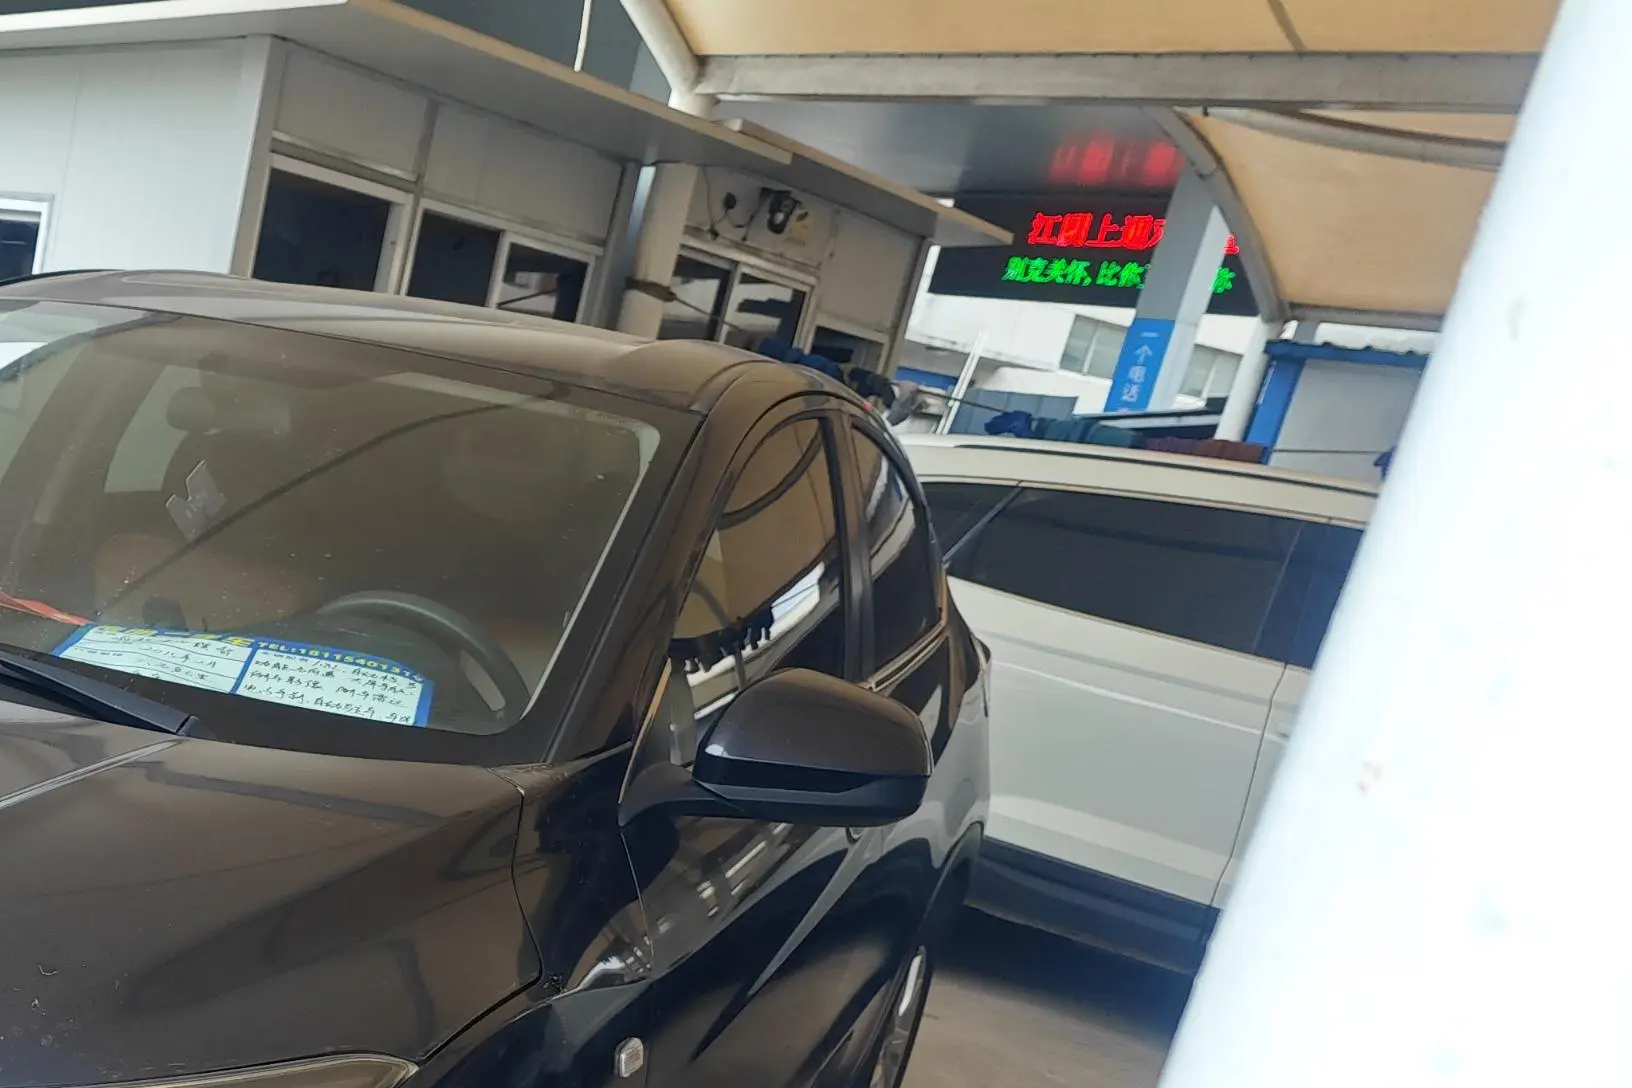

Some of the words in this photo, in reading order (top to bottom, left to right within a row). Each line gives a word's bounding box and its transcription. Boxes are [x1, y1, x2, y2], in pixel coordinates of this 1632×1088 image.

[1001, 256, 1152, 289] 别克关怀,比你
[1120, 331, 1160, 413] 一个电话
